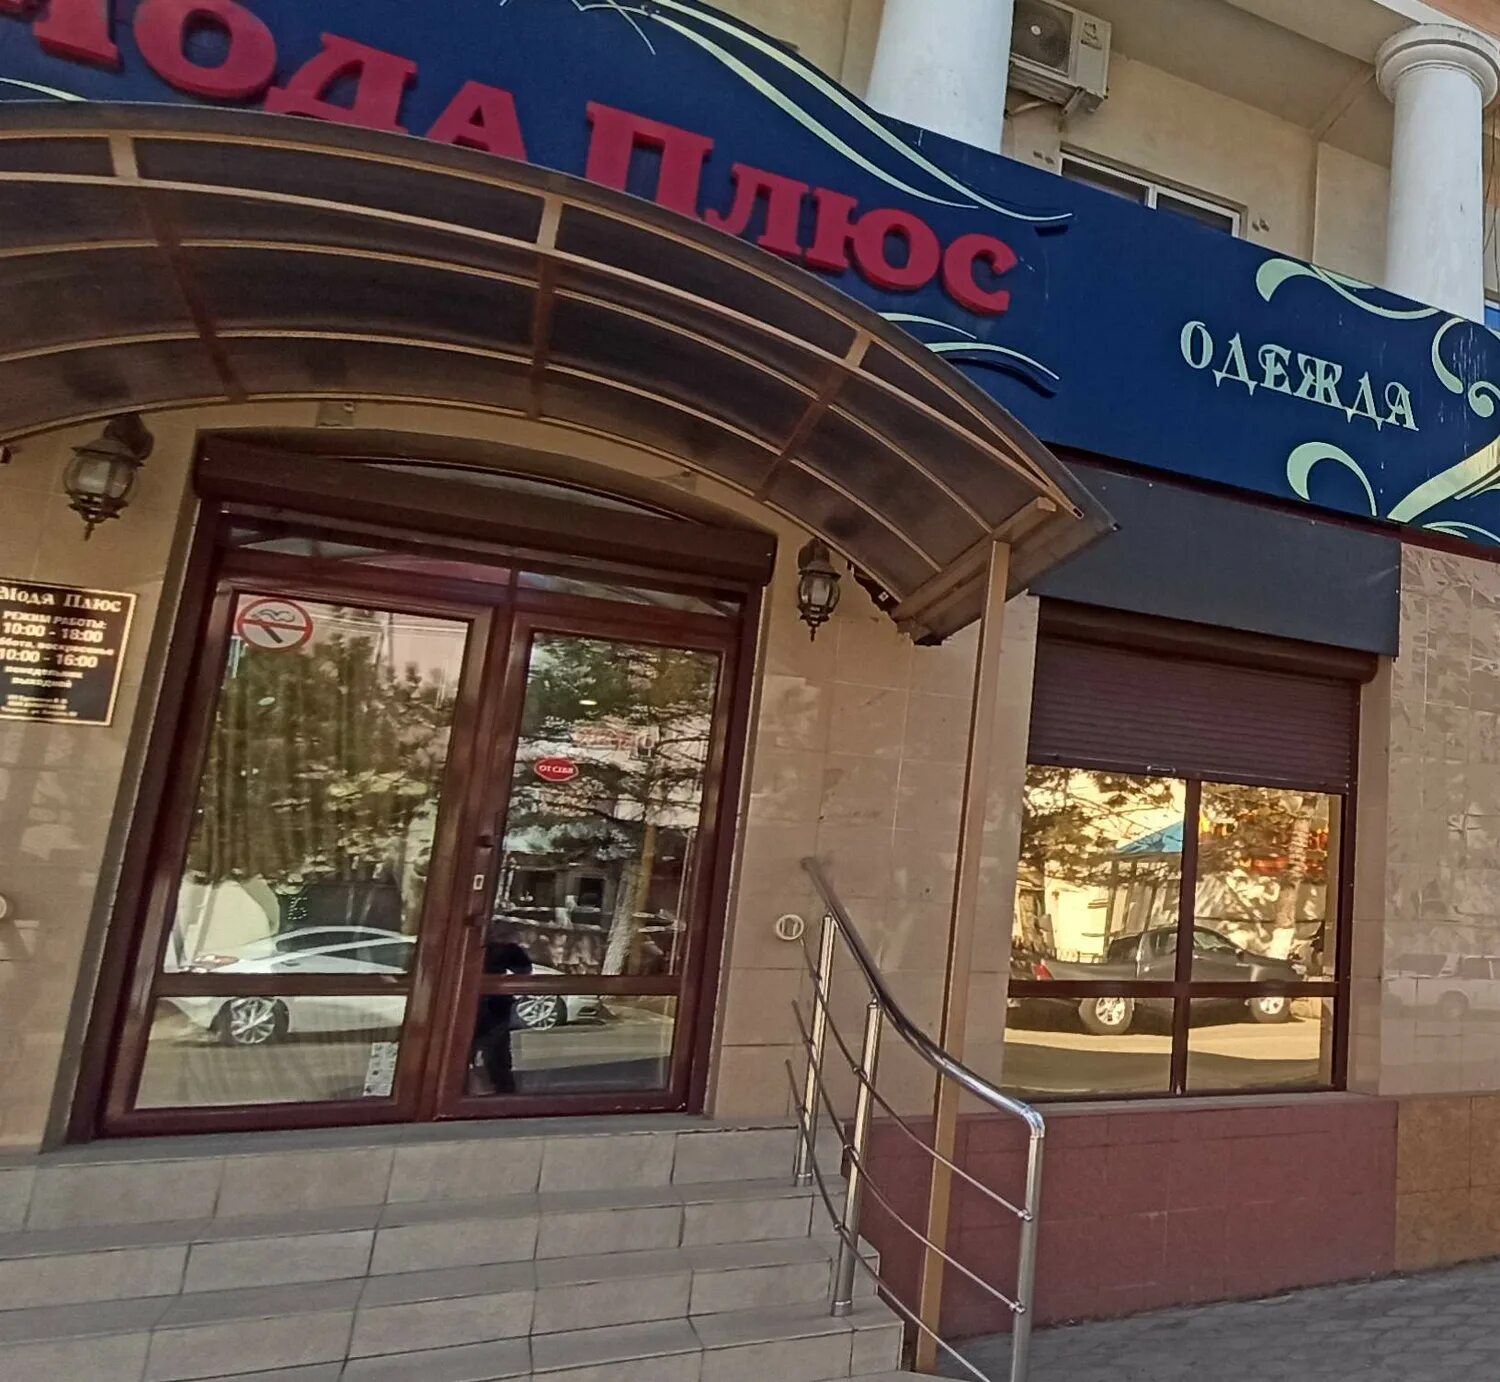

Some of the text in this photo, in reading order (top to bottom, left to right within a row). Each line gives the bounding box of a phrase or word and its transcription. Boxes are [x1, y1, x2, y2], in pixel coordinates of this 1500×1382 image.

[1180, 320, 1420, 432] ОДЕЖДА
[2, 610, 51, 624] РЕЖИМ
[0, 636, 35, 649] ббота,
[3, 622, 46, 638] 10:00
[62, 628, 104, 644] 18:00
[0, 647, 41, 663] 10:00
[56, 653, 99, 669] 16:00
